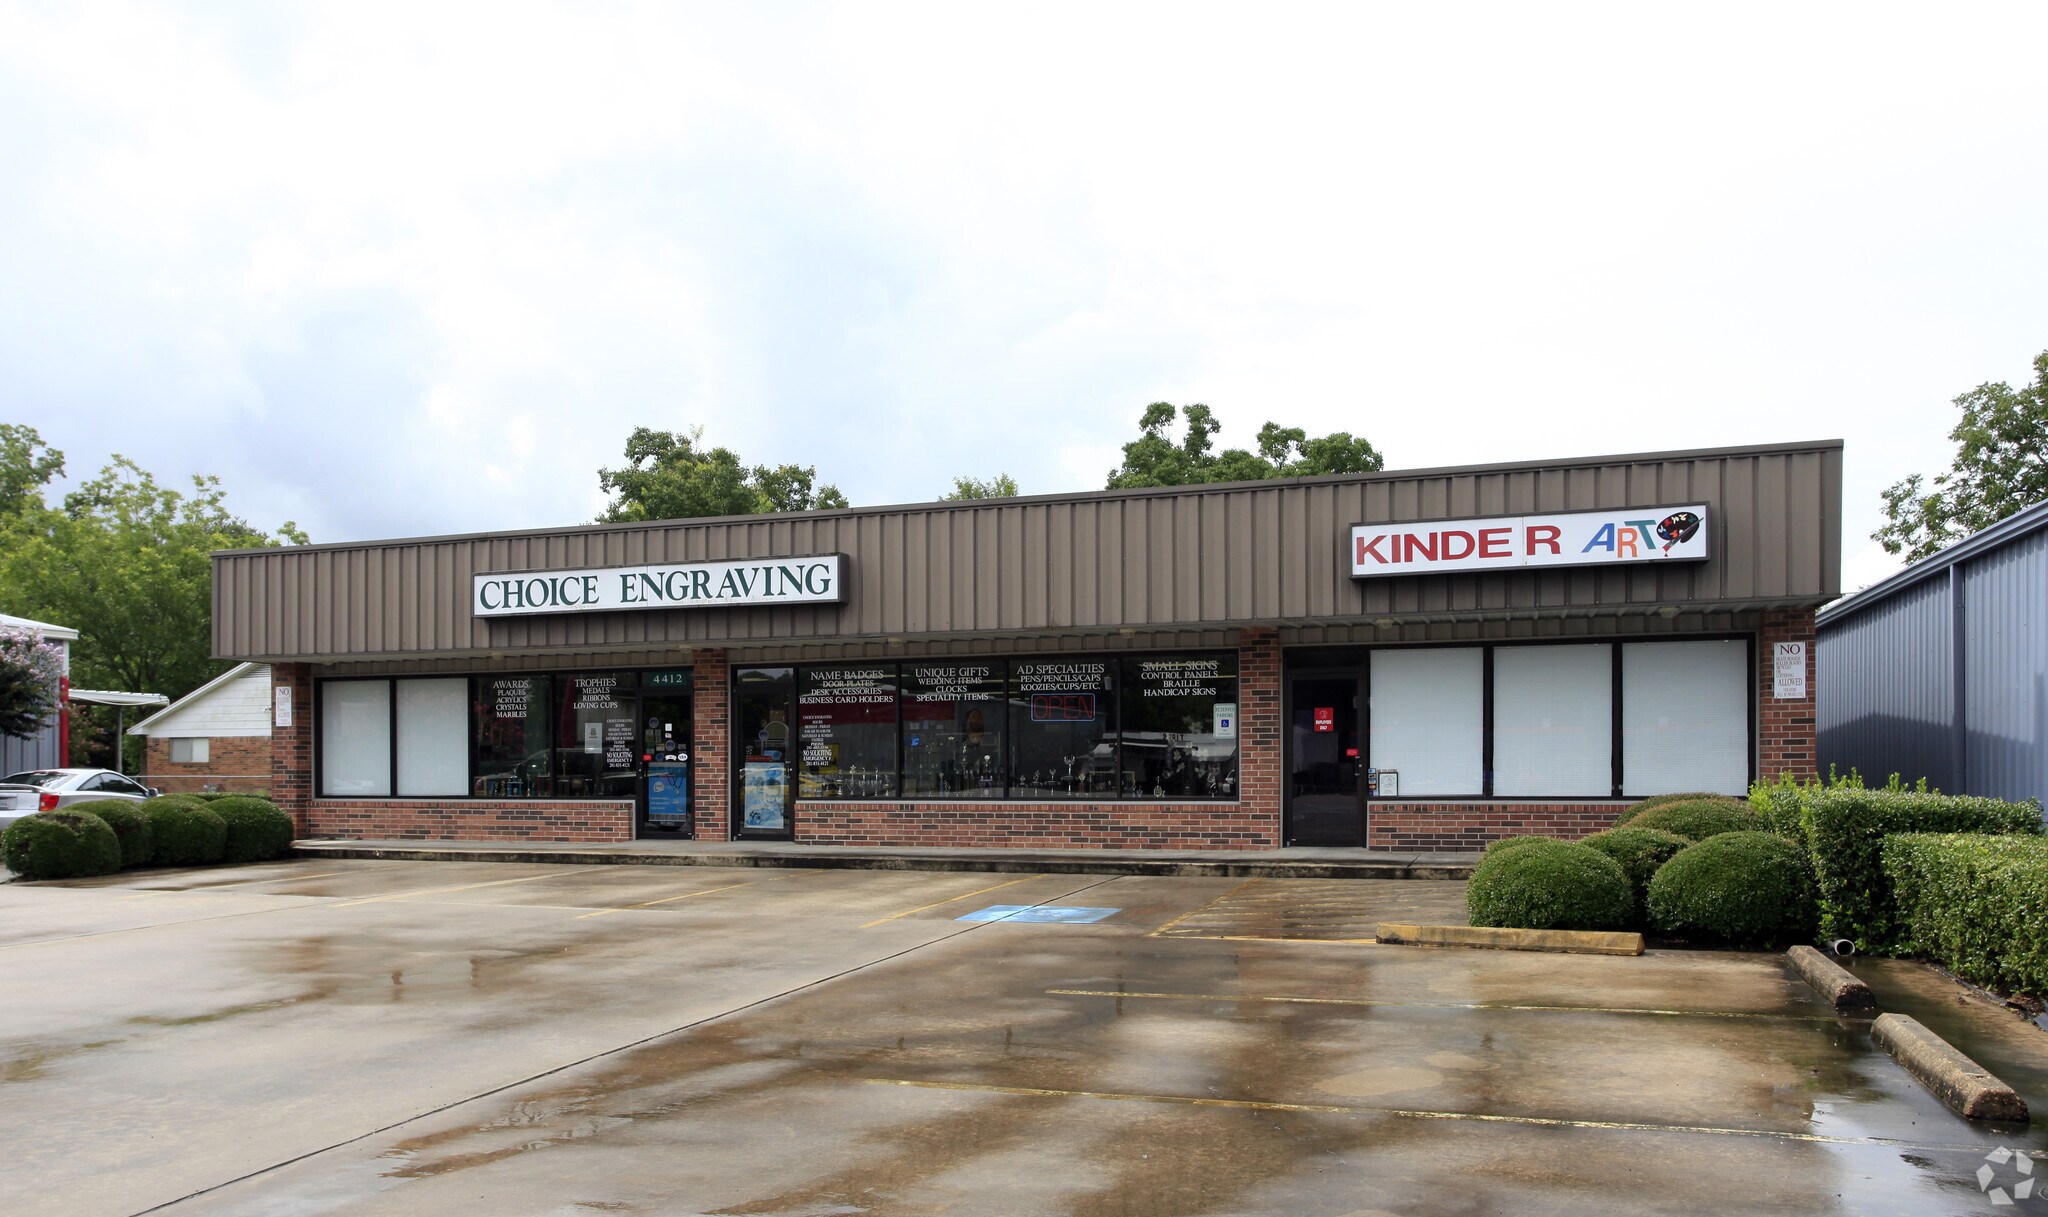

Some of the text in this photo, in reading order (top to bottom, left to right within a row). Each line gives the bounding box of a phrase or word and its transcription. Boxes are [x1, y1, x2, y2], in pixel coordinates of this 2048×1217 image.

[1356, 520, 1658, 566] KINDER ART
[480, 564, 832, 610] CHOICE ENGRAVING
[1780, 644, 1800, 654] NO
[1017, 664, 1104, 674] AD SPECIALTIES
[1142, 661, 1217, 671] SMALL SIGNS
[810, 670, 884, 680] NAME BADGES
[916, 667, 989, 678] UNIQUE GIFTS
[574, 678, 617, 688] TROPHIES
[653, 674, 682, 683] 4412
[1020, 674, 1101, 682] PENS/PENCILS/CAPS
[1778, 678, 1802, 686] ALLOWED
[493, 680, 529, 688] AWARDS
[1020, 683, 1101, 691] KOOZIES/CUPS/ETC.
[1144, 688, 1190, 696] HANDICAP
[1034, 696, 1094, 719] OPEN
